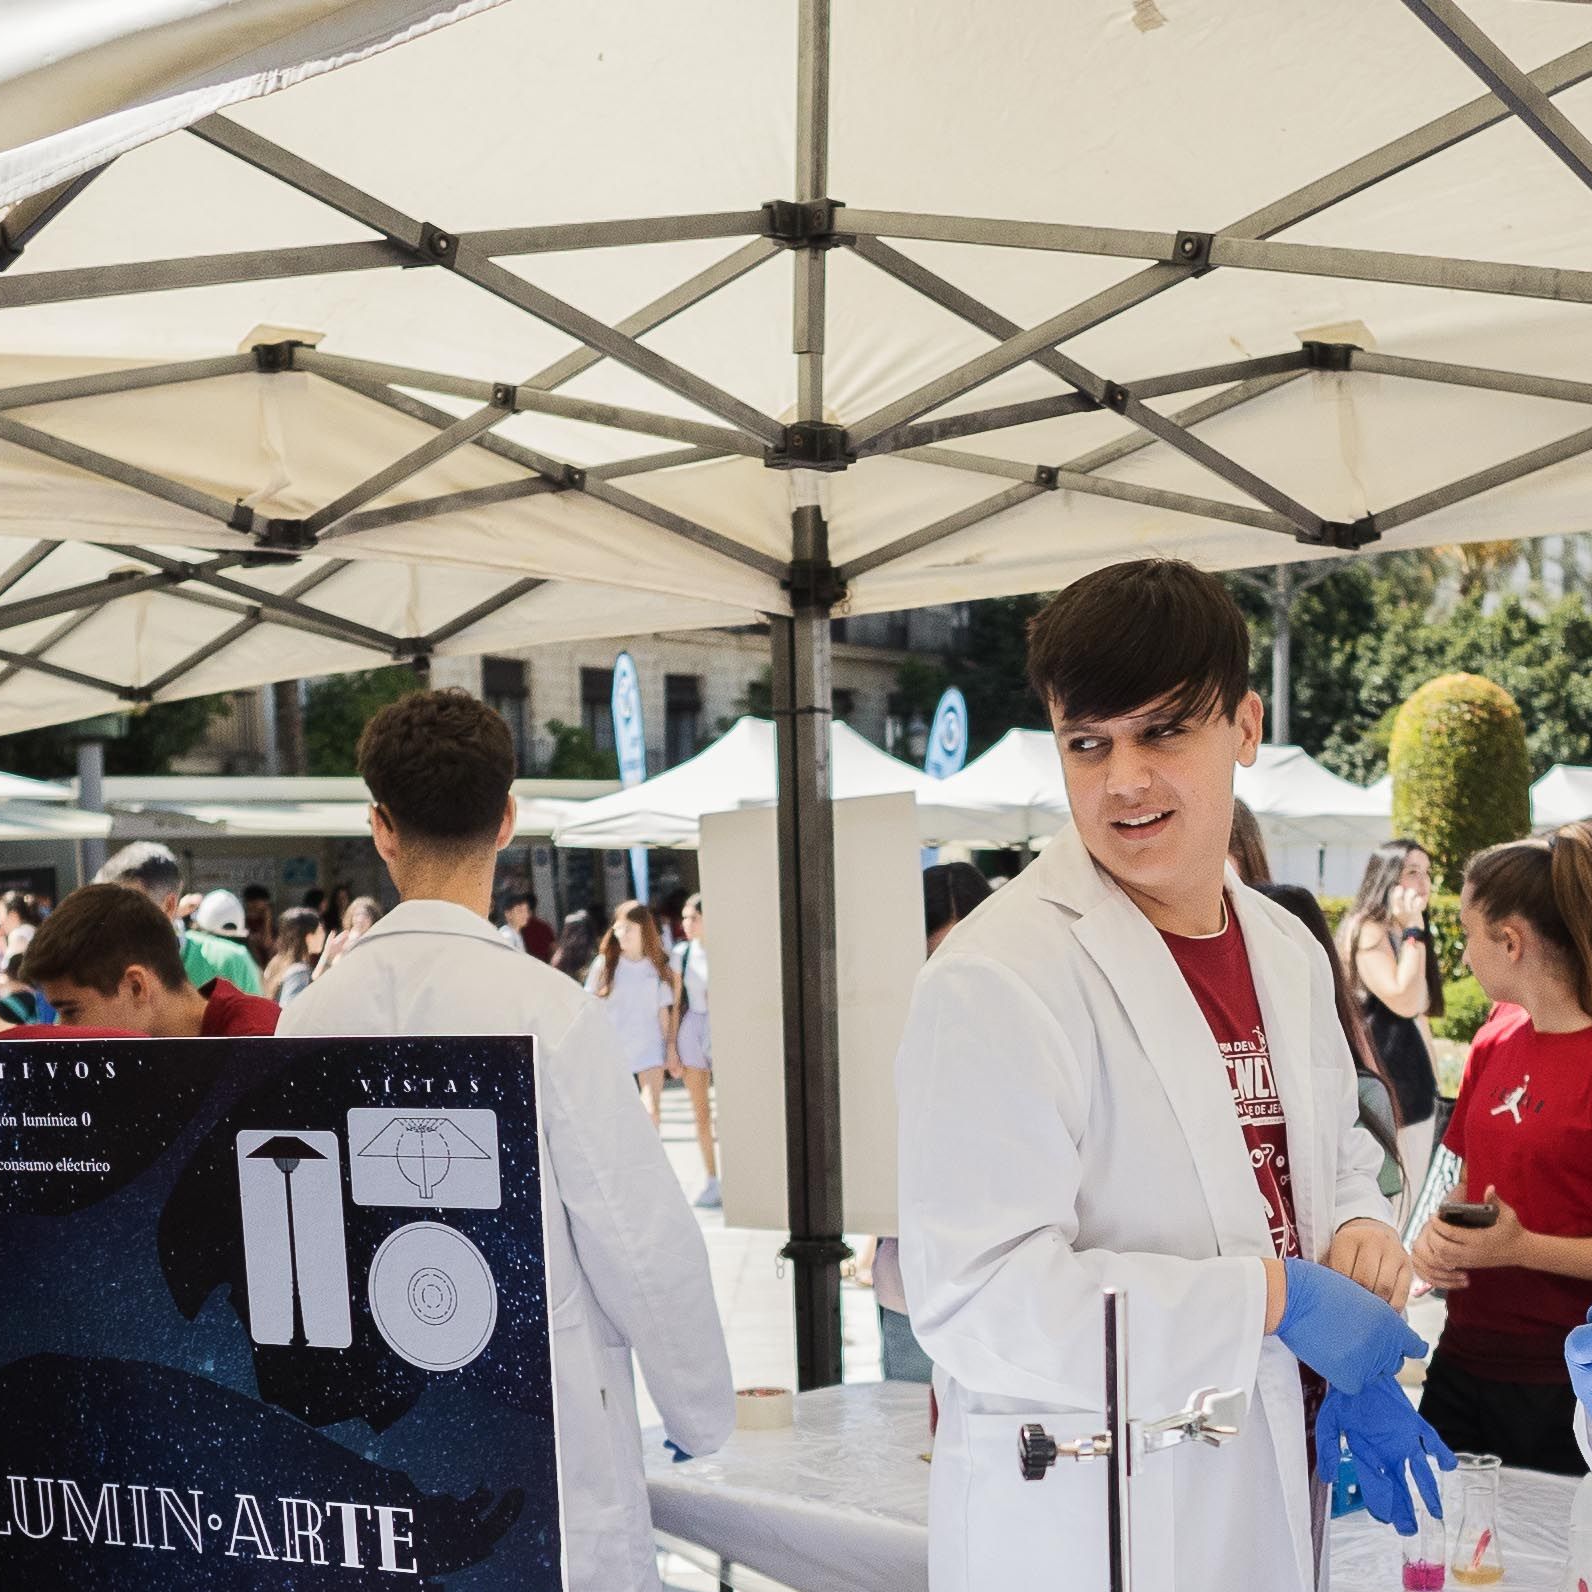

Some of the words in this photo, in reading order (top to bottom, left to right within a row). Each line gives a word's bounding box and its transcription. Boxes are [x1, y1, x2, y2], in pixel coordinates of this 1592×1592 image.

[360, 1079, 479, 1093] VISTAS
[22, 1112, 78, 1127] lumínica
[56, 1158, 111, 1172] eléctrico
